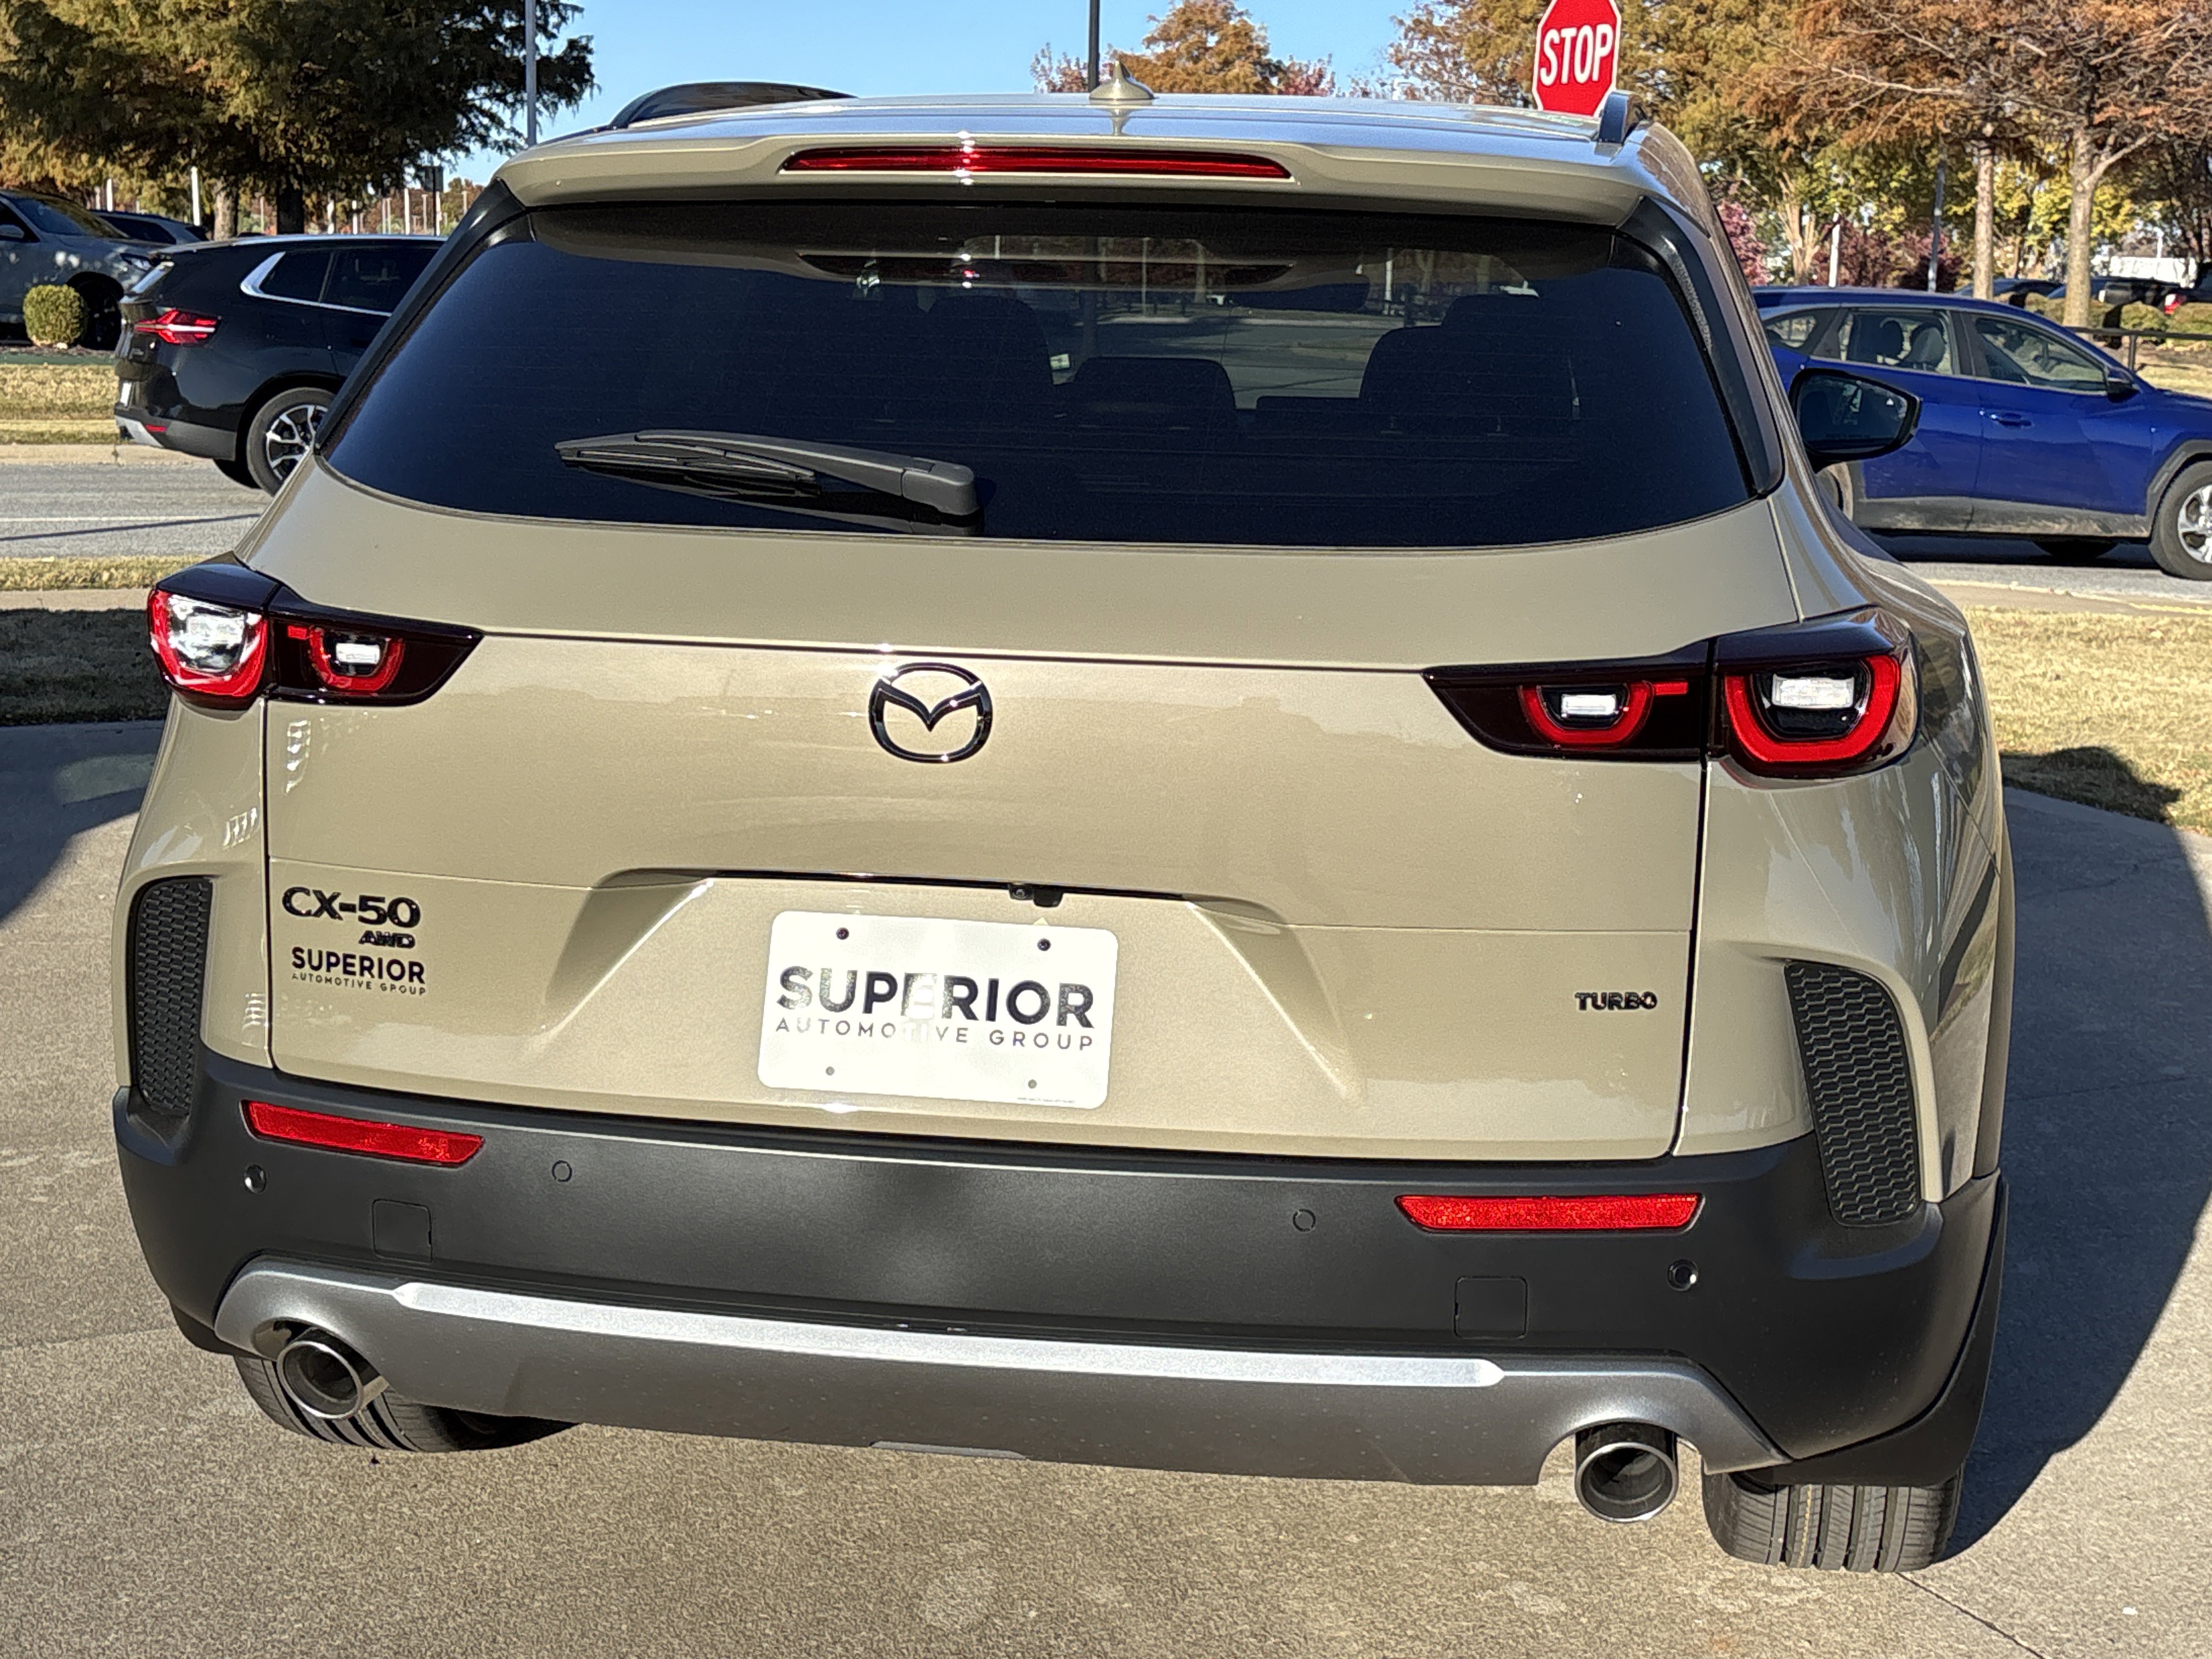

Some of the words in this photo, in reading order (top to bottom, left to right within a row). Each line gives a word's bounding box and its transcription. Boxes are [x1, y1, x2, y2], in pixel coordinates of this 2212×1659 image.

[1540, 24, 1613, 86] STOP
[282, 887, 421, 928] CX-50
[358, 930, 416, 949] AWD
[292, 946, 425, 984] SUPERIOR
[292, 973, 372, 990] AUTOMOTIVE
[380, 983, 426, 996] GROUP
[776, 966, 1094, 1029] SUPERIOR
[1575, 991, 1658, 1011] TURBO
[775, 1017, 968, 1043] AUTOMOTIVE
[989, 1029, 1092, 1051] GROUP
